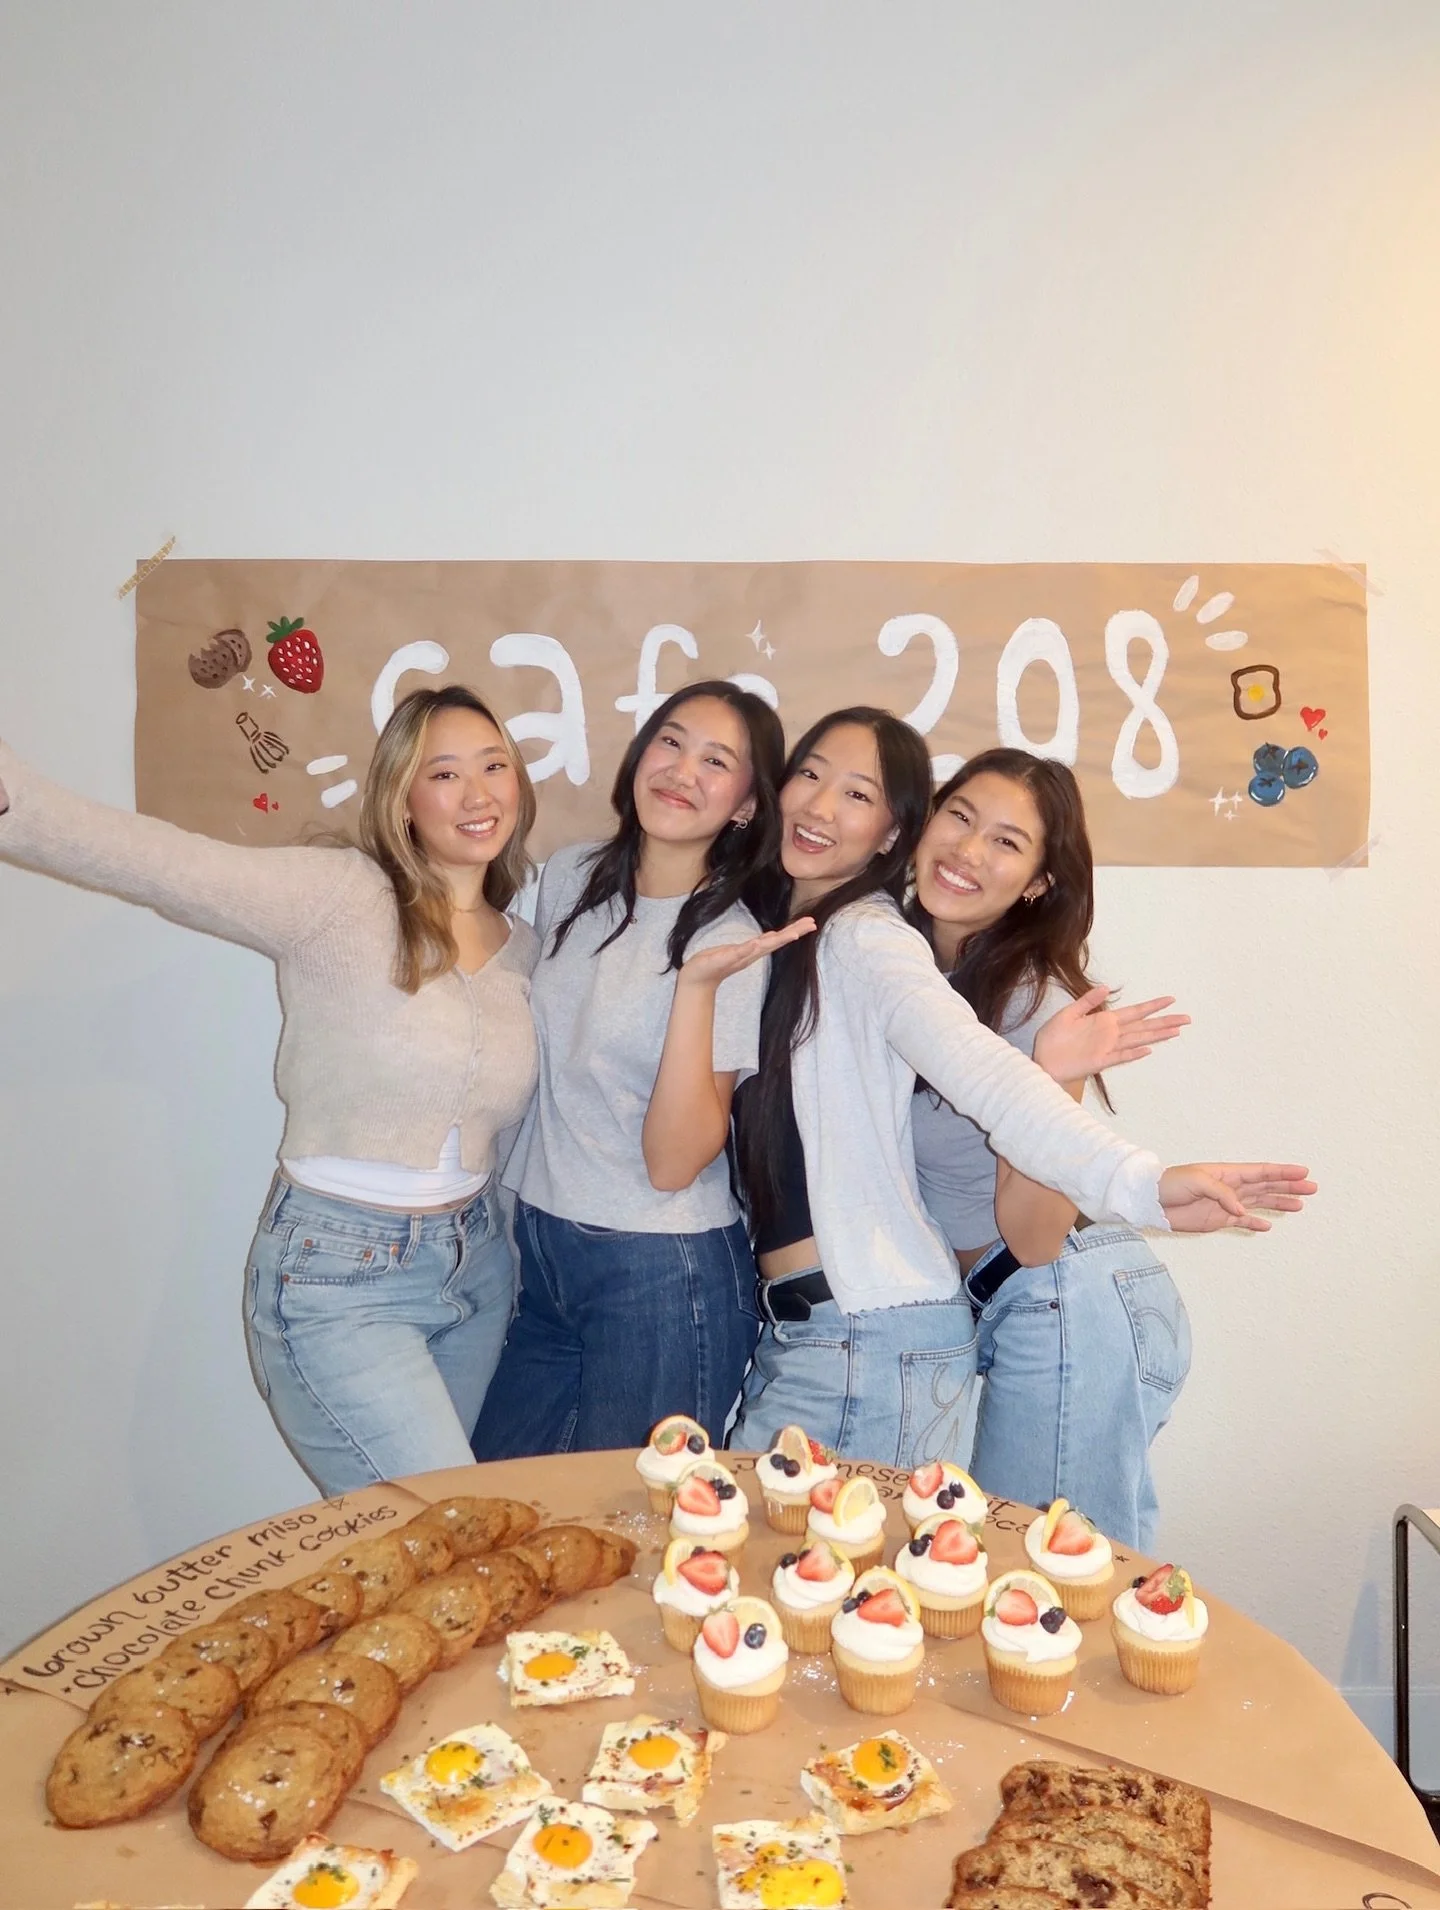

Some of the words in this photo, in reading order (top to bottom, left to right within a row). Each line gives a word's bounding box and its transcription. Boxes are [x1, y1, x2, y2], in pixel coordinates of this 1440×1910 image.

[877, 609, 1180, 799] 208
[22, 1609, 148, 1678] brown
[132, 1544, 232, 1605] butter
[247, 1513, 317, 1548] miso
